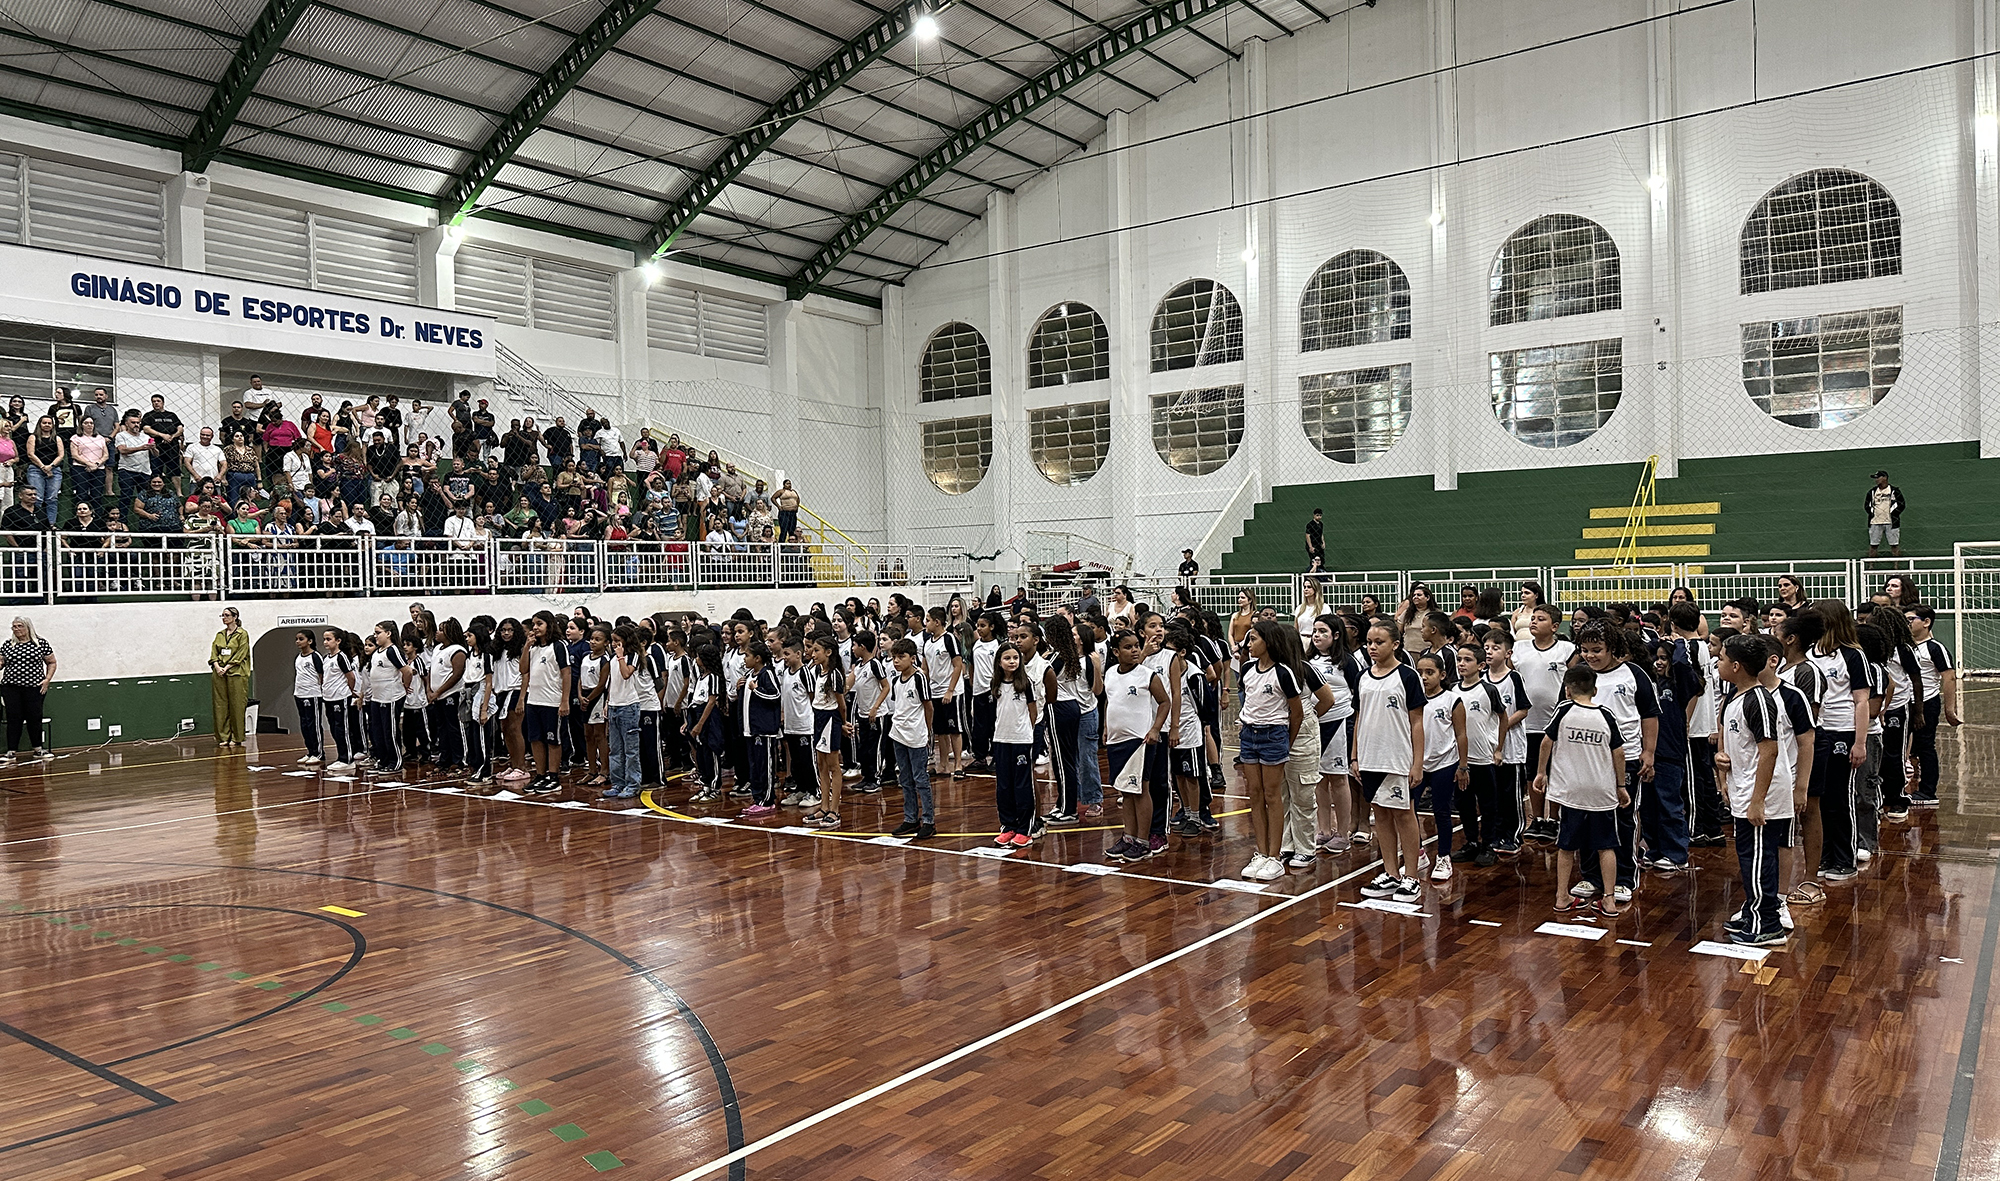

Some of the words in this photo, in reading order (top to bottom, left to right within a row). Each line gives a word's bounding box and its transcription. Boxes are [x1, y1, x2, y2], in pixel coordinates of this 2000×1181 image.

[71, 272, 182, 309] GINÁSIO
[194, 289, 230, 316] DE
[242, 296, 370, 334] ESPORTES
[380, 316, 405, 339] Dr.
[414, 321, 483, 349] NEVES
[1568, 730, 1603, 743] JAHU
